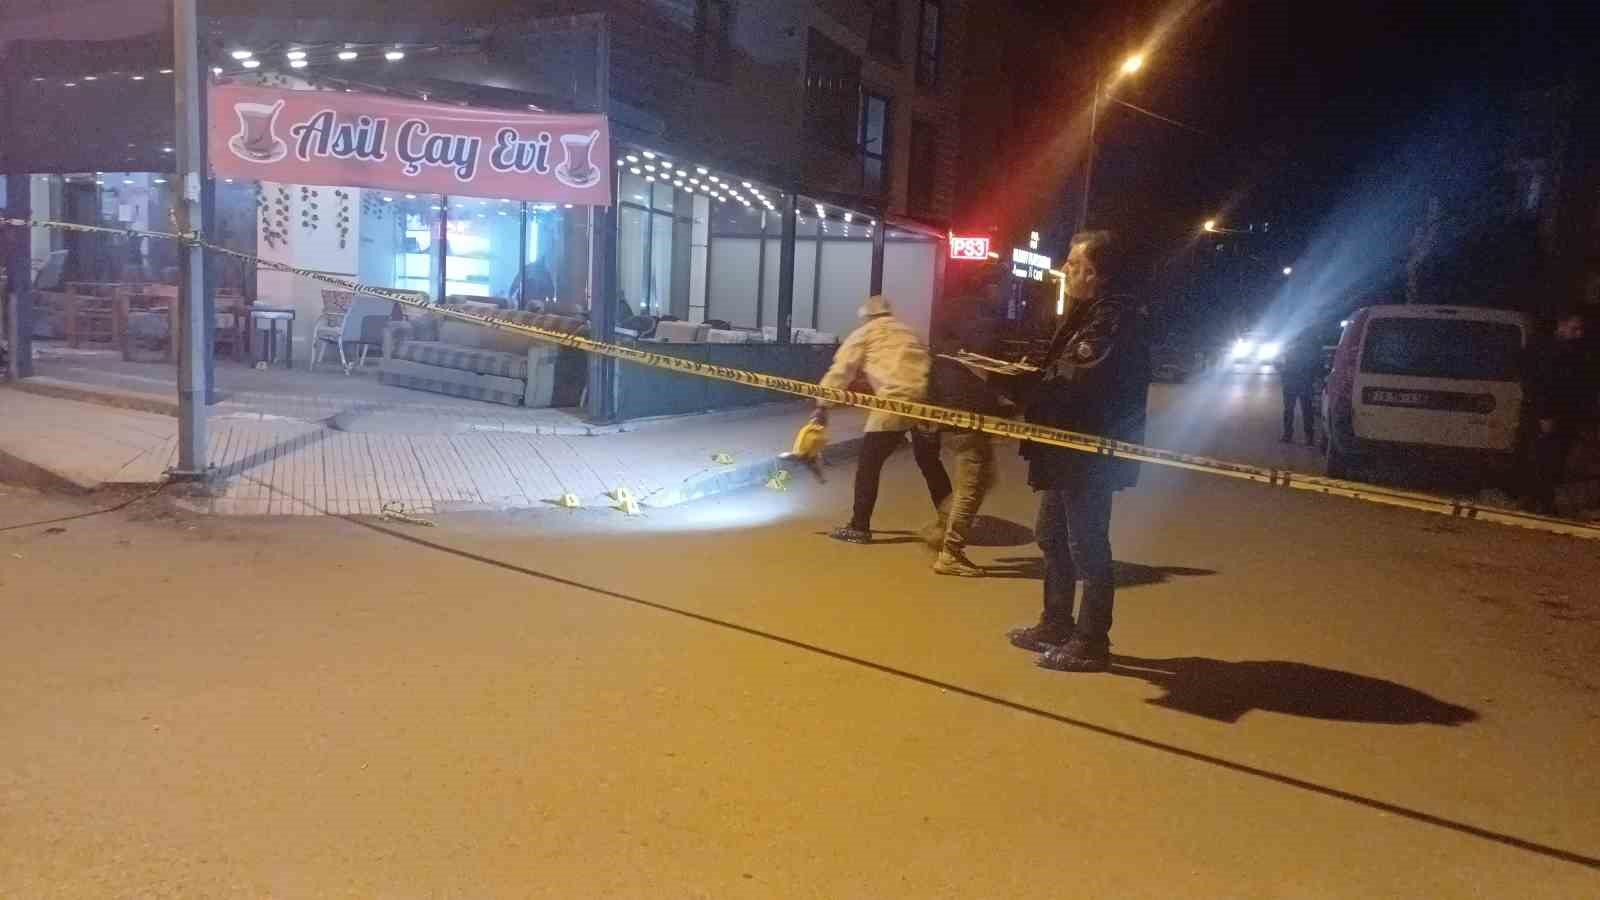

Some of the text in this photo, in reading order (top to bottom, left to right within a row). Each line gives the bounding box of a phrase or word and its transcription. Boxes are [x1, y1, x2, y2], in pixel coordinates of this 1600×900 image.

[291, 111, 550, 181] Asil Çay Evi
[954, 239, 983, 258] PS3
